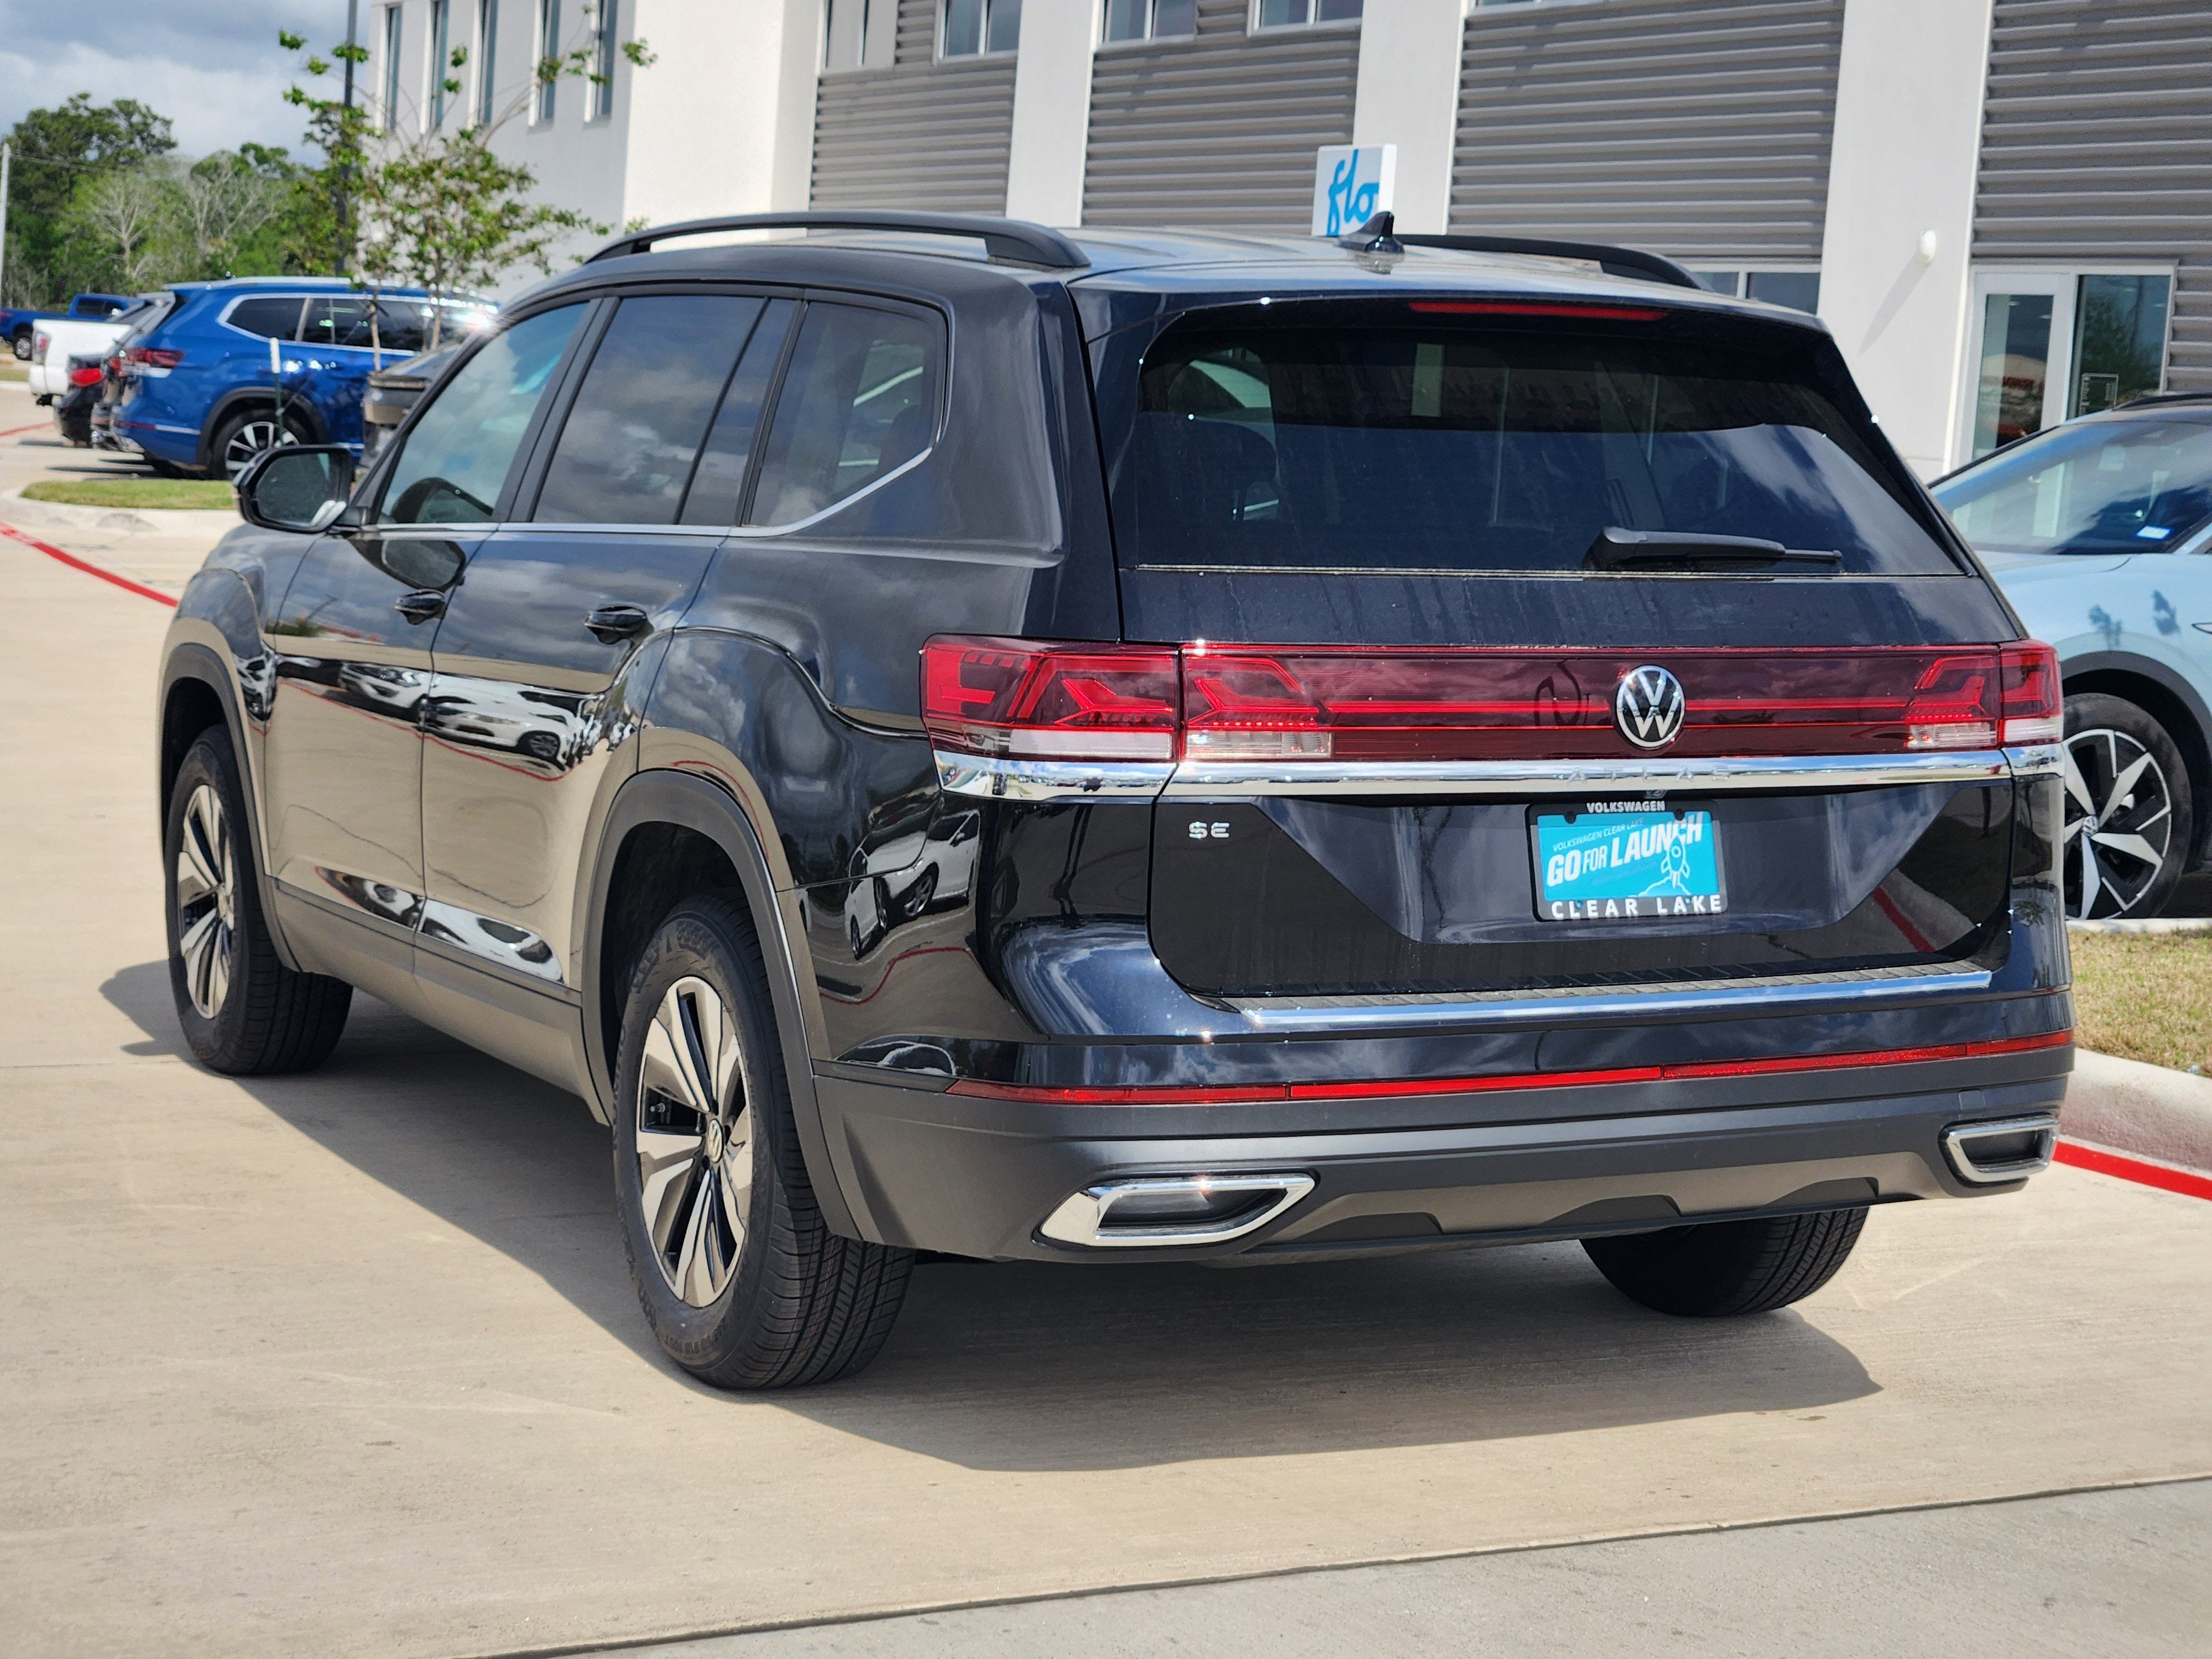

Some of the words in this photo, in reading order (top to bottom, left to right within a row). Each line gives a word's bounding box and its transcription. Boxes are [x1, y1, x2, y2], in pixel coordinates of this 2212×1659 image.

[1621, 668, 1682, 742] VW
[1566, 765, 1730, 786] ATLAS
[1586, 801, 1666, 813] VOLKSWAGEN
[1189, 822, 1230, 839] SE
[1553, 831, 1603, 852] VOLKSWAGEN
[1604, 823, 1626, 837] CLEAR
[1627, 818, 1644, 830] LAKE
[1547, 849, 1582, 887] GO
[1582, 845, 1608, 874] FOR
[1610, 812, 1703, 868] LAUNCH
[1551, 898, 1639, 920] CLEAR
[1656, 894, 1722, 915] LAKE
